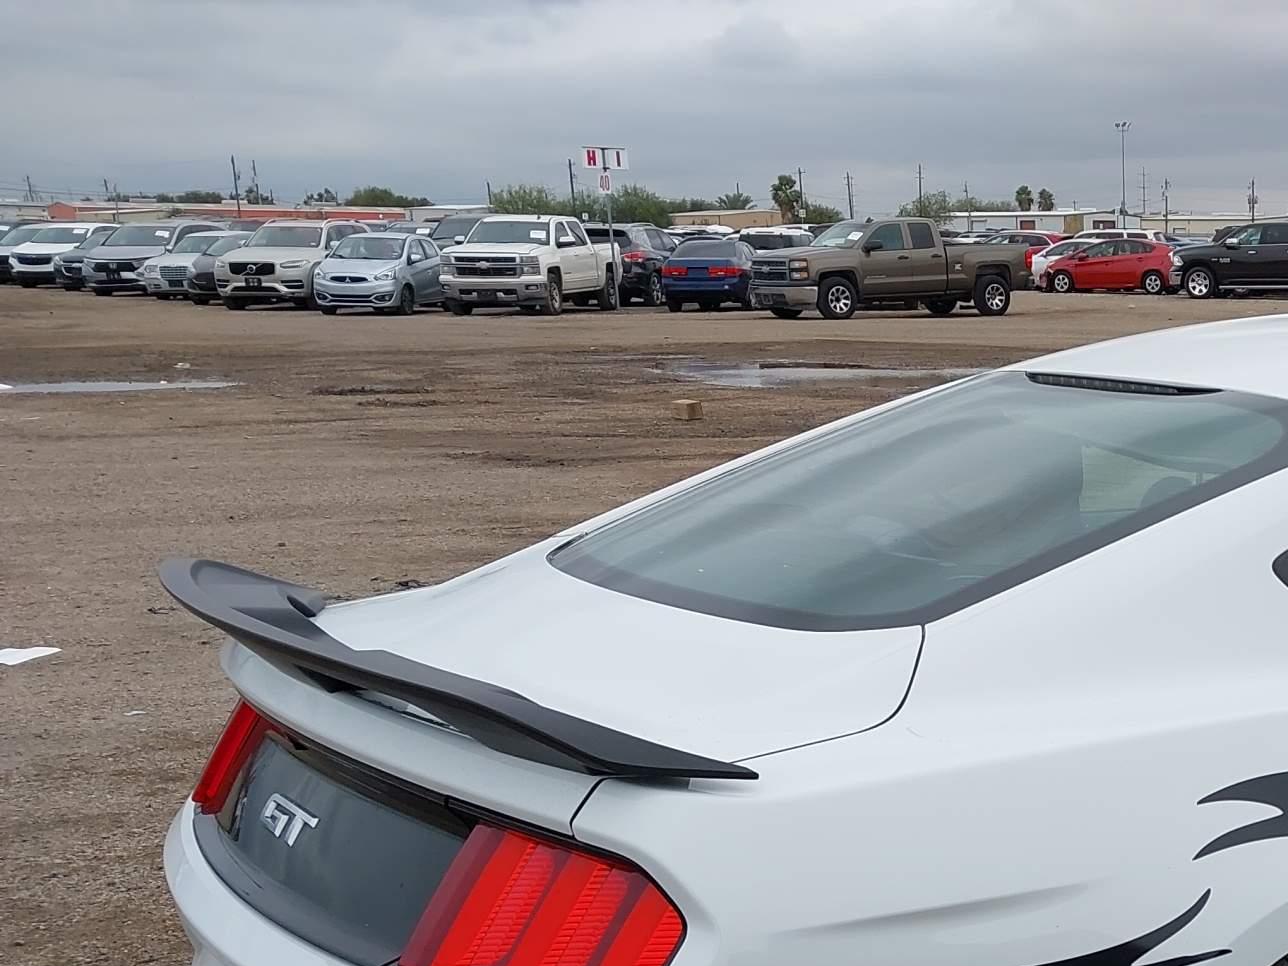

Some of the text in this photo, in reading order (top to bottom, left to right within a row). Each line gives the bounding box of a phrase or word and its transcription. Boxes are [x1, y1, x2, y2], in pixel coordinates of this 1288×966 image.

[586, 149, 622, 168] H I
[599, 175, 610, 192] 40
[260, 792, 321, 848] GT
